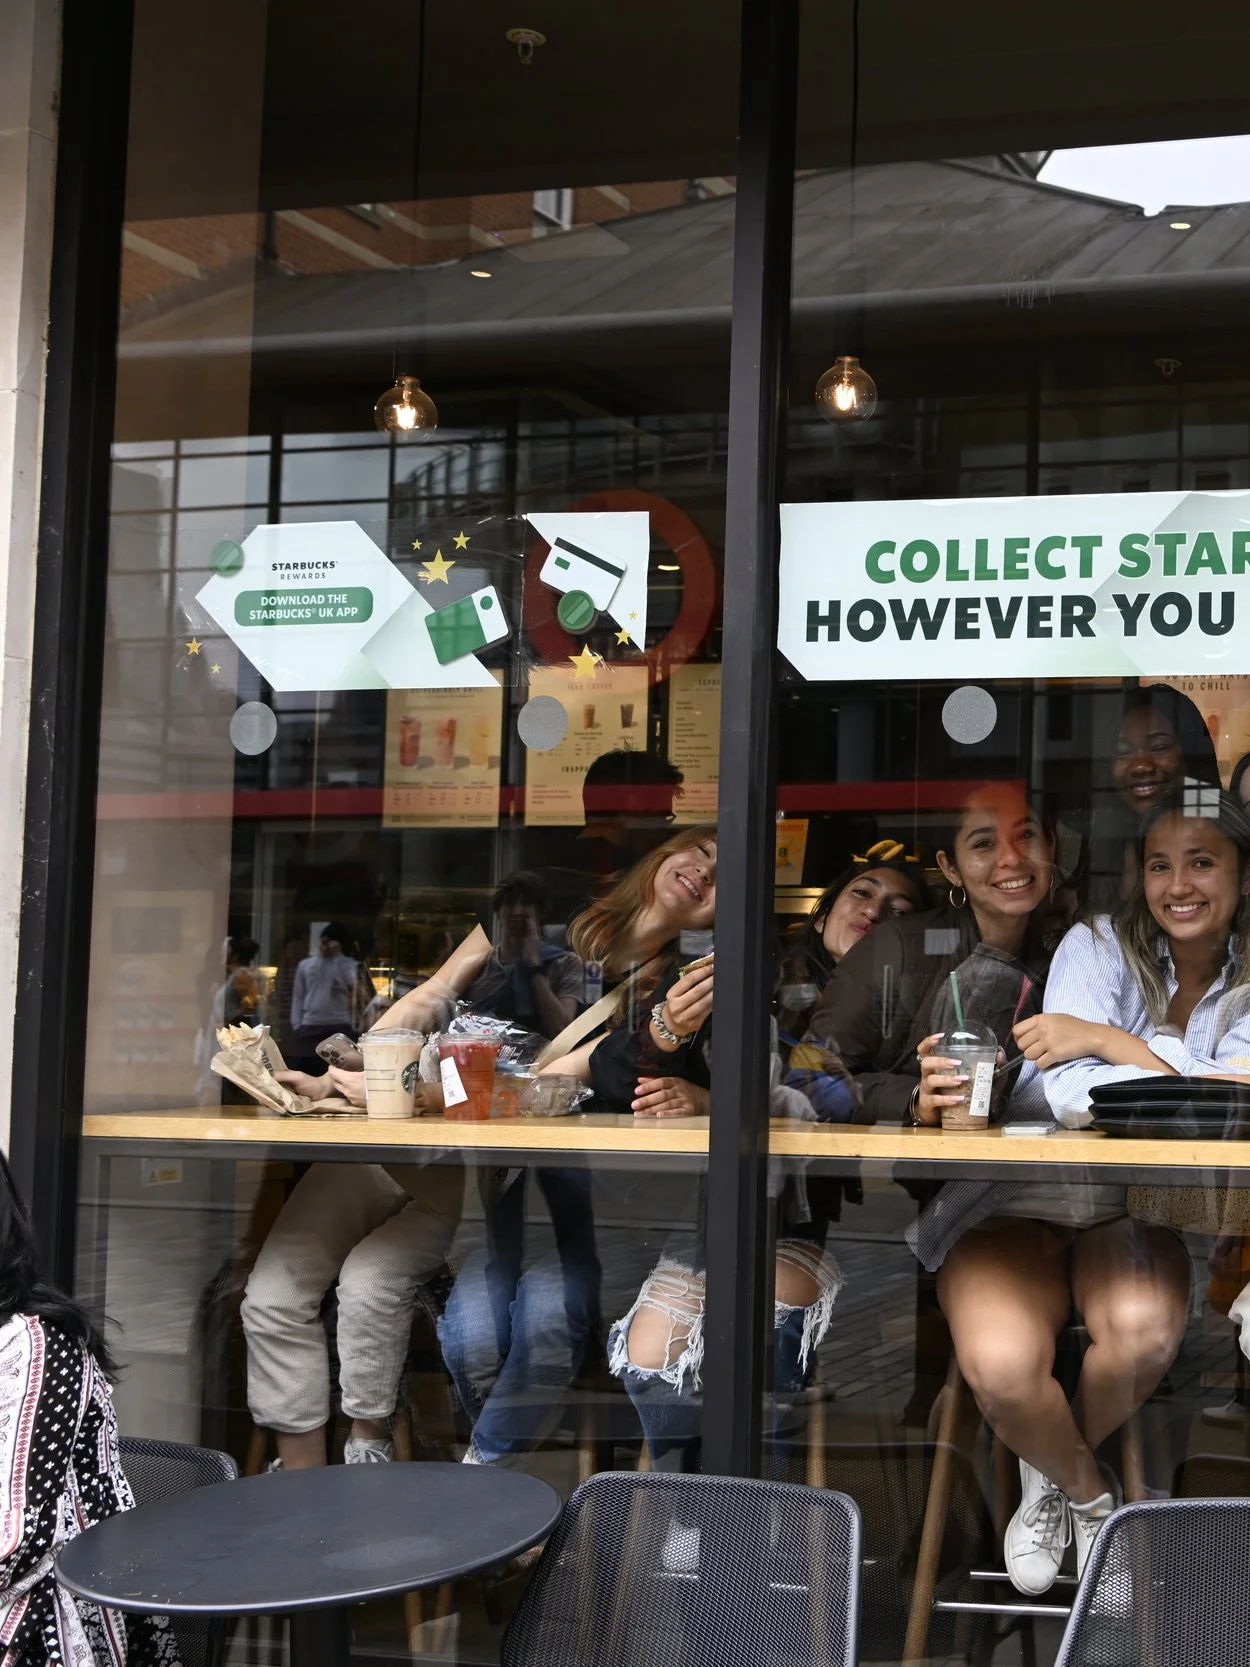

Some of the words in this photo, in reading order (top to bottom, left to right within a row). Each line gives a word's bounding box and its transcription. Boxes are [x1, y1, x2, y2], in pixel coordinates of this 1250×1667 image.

[865, 535, 1103, 584] COLLECT
[280, 572, 326, 580] REWARDS
[260, 594, 325, 606] DOWNLOAD
[327, 594, 348, 604] THE
[318, 607, 334, 618] UK
[336, 607, 358, 617] APP
[805, 595, 1097, 643] HOWEVER
[1111, 590, 1236, 638] YOU
[1182, 682, 1194, 691] TO
[1200, 682, 1230, 691] CHILL
